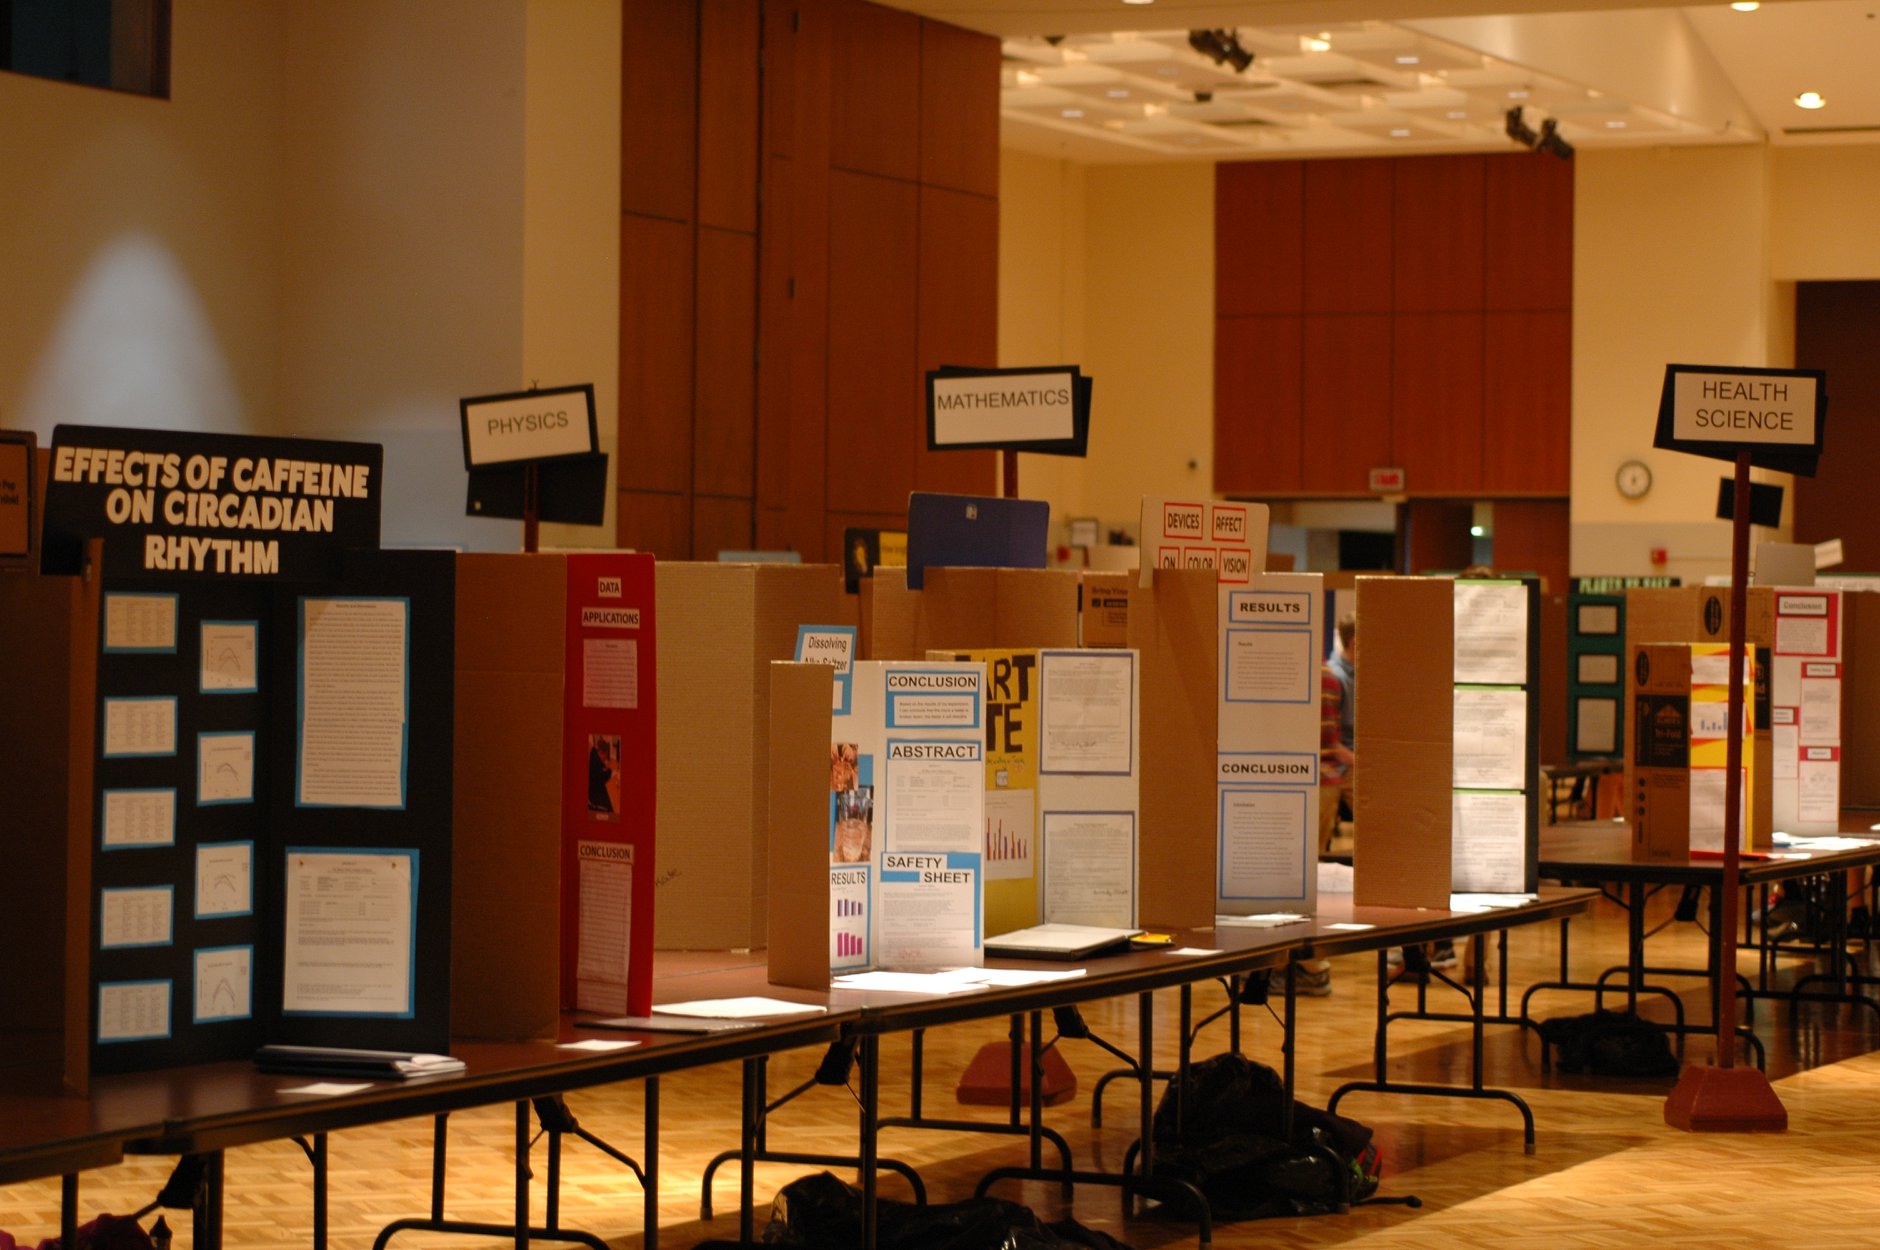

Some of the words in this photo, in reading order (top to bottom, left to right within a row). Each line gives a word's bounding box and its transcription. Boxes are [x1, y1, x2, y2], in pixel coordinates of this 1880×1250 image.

[937, 389, 1070, 410] MATHEMATICS
[1703, 381, 1788, 402] HEALTH
[487, 411, 569, 436] PHYSICS
[1696, 409, 1793, 430] SCIENCE
[54, 446, 181, 489] EFFECTS
[185, 454, 227, 491] OF
[232, 458, 370, 498] CAFFEINE
[106, 488, 155, 524] ON
[164, 493, 334, 533] CIRCADIAN
[1167, 513, 1200, 530] DEVICES
[1215, 515, 1242, 532] AFFECT
[145, 535, 279, 574] RHYTHM
[1163, 556, 1176, 569] ON
[1187, 556, 1213, 569] COLOR
[1223, 558, 1247, 573] VISION
[600, 582, 620, 593] DATA
[1240, 602, 1301, 613] RESULTS
[1783, 602, 1823, 610] Conclusion
[583, 611, 639, 625] APPLICATIONS
[809, 636, 847, 652] Dissolving
[888, 676, 976, 687] CONCLUSION
[892, 746, 976, 758] ABSTRACT
[1221, 763, 1310, 774] CONCLUSION
[579, 844, 631, 860] CONCLUSION
[887, 856, 942, 868] SAFETY
[831, 871, 866, 886] RESULTS
[924, 872, 971, 884] SHEET
